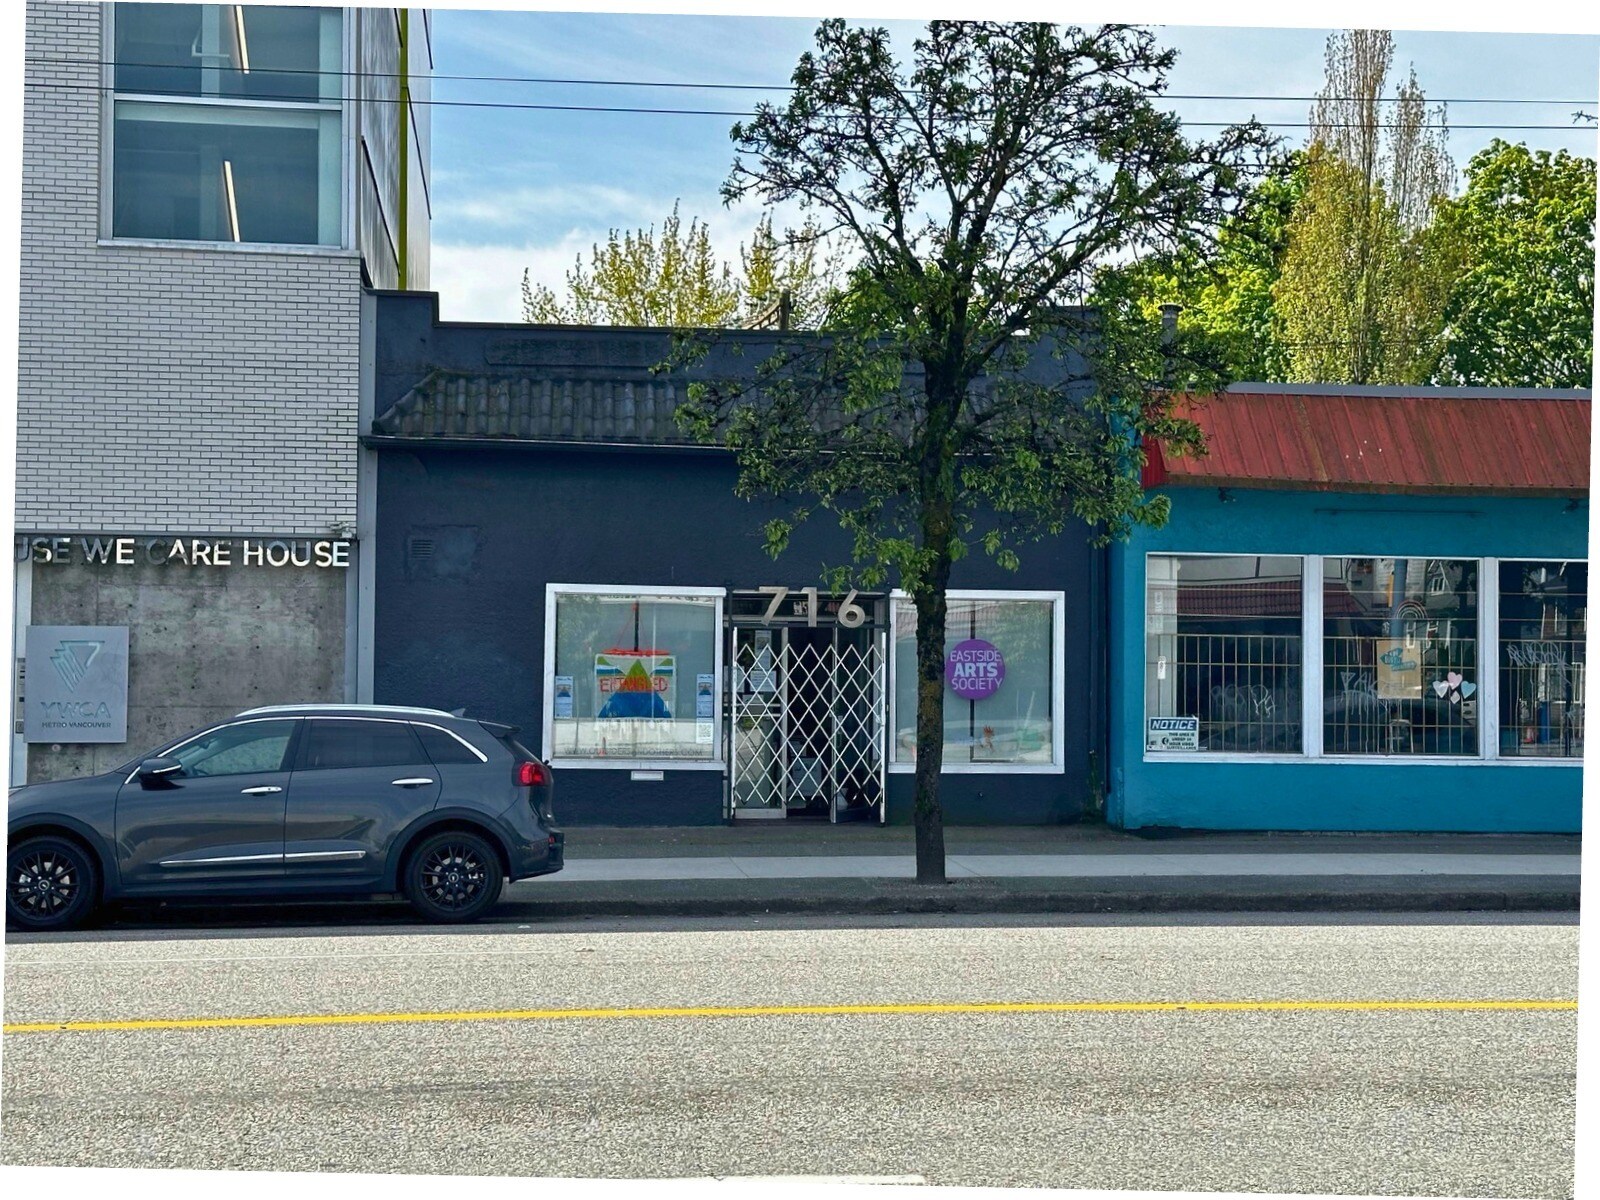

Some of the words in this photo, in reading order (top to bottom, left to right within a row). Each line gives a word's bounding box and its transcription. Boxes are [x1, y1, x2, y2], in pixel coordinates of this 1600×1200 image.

[81, 538, 135, 564] WE
[146, 538, 232, 565] CARE
[243, 539, 350, 567] HOUSE
[759, 586, 866, 628] 716
[950, 650, 1001, 662] EASTSIDE
[954, 662, 998, 678] ARTS
[951, 677, 1003, 690] SOCIETY
[40, 701, 111, 719] YWCA
[1152, 720, 1196, 730] NOTICE
